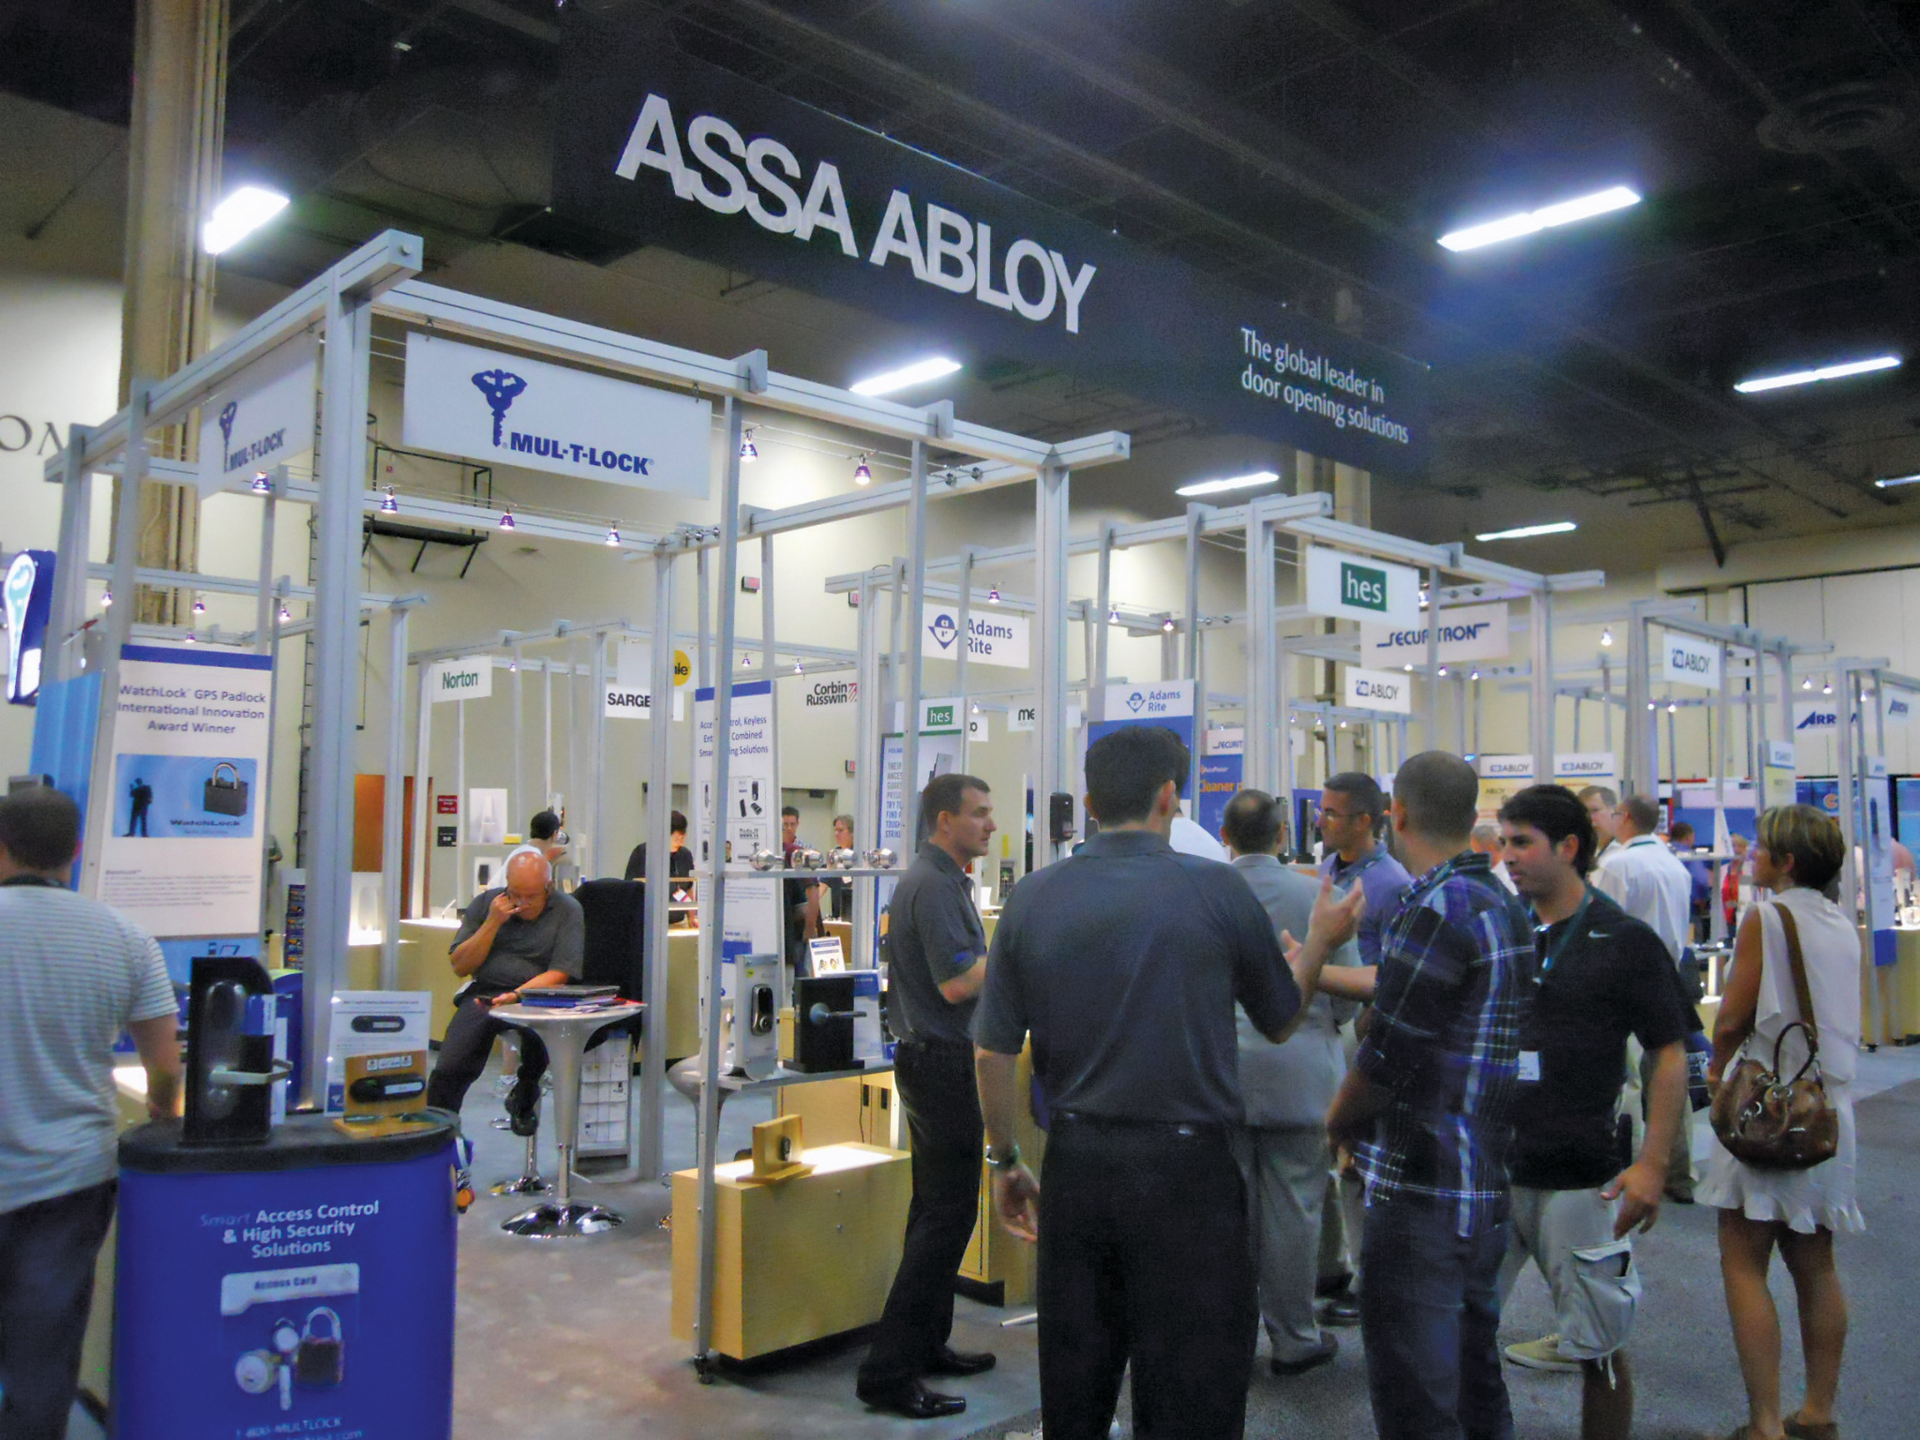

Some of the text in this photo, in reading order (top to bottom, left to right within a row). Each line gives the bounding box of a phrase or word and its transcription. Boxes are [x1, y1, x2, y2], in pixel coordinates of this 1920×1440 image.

[615, 93, 1098, 335] ASSA ABLOY
[1240, 327, 1385, 404] The global leader in
[1241, 363, 1409, 444] door opening solutions
[230, 427, 286, 471] MUL-T-LOCK
[510, 431, 650, 476] MUL-T-LOCK
[1347, 570, 1383, 604] hes
[968, 618, 1014, 640] Adams
[967, 636, 993, 656] Rite
[1685, 652, 1711, 673] ABLOY
[442, 670, 478, 690] Norton
[814, 680, 848, 696] Corbin
[194, 689, 218, 700] GPS
[221, 691, 266, 703] Padlock
[1149, 689, 1181, 701] Adams
[1370, 683, 1399, 700] ABLOY
[607, 692, 651, 708] SARGE
[806, 693, 848, 707] Russwin
[1148, 702, 1167, 712] Rite
[118, 702, 265, 719] International Innovation
[930, 710, 950, 723] hes
[147, 720, 236, 734] Award Winner
[700, 721, 713, 729] Acce
[743, 715, 767, 727] Keyless
[703, 730, 763, 743] Ent Combined
[1213, 740, 1243, 749] SECURIT
[739, 744, 769, 755] Solutions
[1502, 764, 1530, 772] ABLOY
[1575, 761, 1604, 771] ABLOY
[200, 1199, 380, 1227] Smart Access Control
[222, 1220, 356, 1244] & High Security
[251, 1239, 332, 1259] Solutions
[254, 1275, 317, 1290] Access Card
